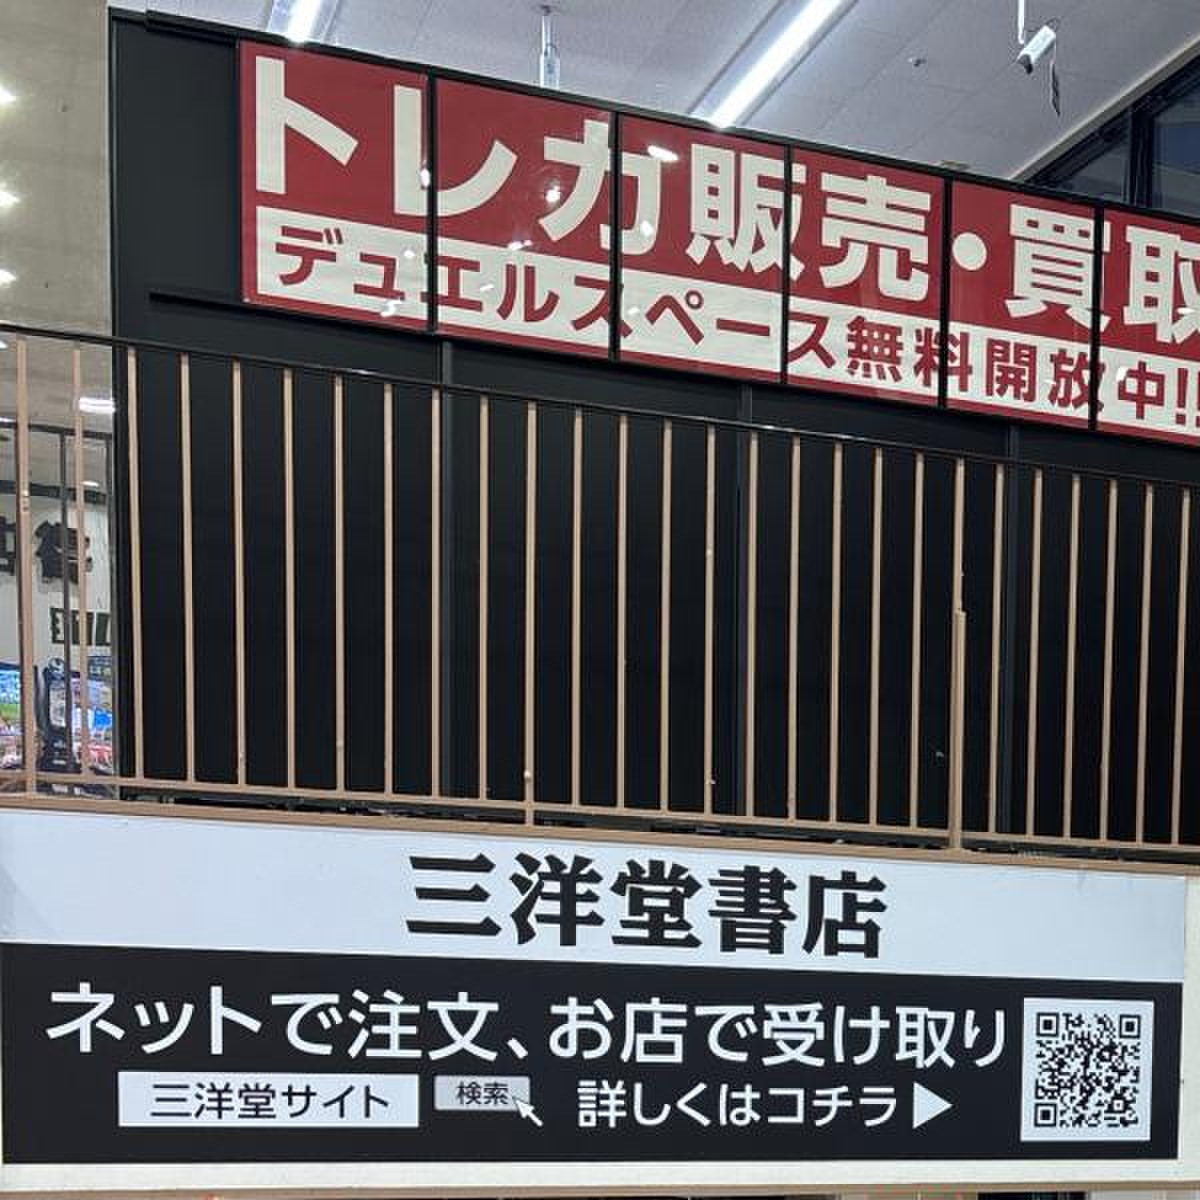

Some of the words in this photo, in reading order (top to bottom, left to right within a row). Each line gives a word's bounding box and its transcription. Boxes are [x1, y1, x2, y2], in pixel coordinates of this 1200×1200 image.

[406, 853, 888, 959] 三洋堂書店
[46, 982, 1005, 1069] ネットで注文、お店で受け取り
[150, 1082, 390, 1120] 三洋堂サイト
[456, 1081, 509, 1106] 検索
[577, 1079, 898, 1129] 詳しくはコチラ
